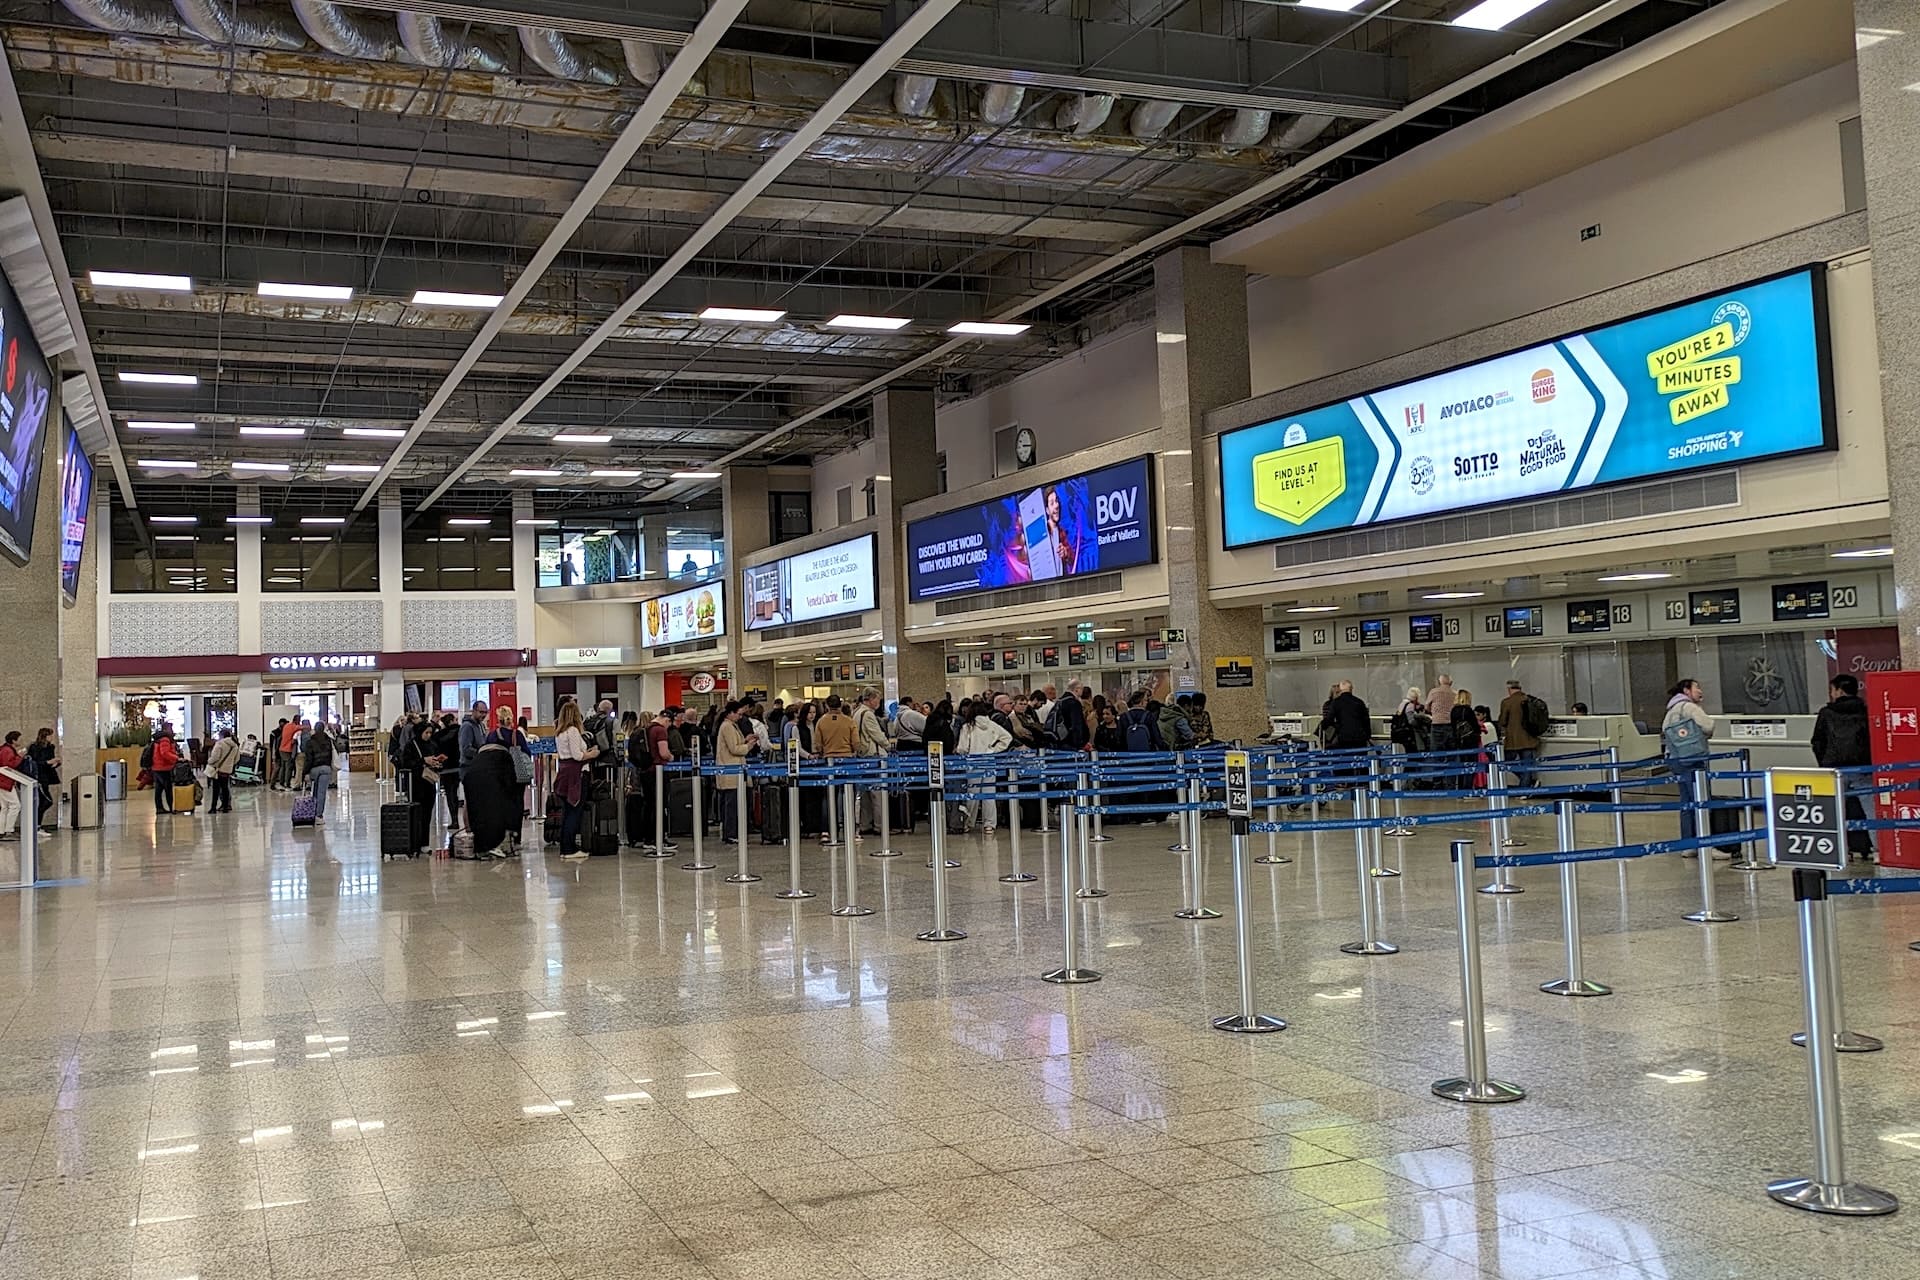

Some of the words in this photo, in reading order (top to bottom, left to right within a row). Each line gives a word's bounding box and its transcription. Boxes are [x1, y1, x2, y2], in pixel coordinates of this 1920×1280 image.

[1656, 336, 1712, 369] YOU'RE
[1716, 331, 1725, 345] 2
[1531, 377, 1555, 389] BURGER
[1665, 364, 1732, 387] MINUTES
[1532, 384, 1556, 399] KING
[1440, 395, 1494, 420] AVOTACO
[1677, 388, 1720, 418] AWAY
[1410, 426, 1423, 434] KFC
[1703, 431, 1727, 441] AIRPORT
[1520, 439, 1566, 465] NATURAL
[1668, 438, 1728, 459] SHOPPING
[1274, 468, 1293, 481] FIND
[1294, 465, 1306, 476] US
[1308, 462, 1318, 473] AT
[1520, 461, 1543, 477] GOOD
[1545, 452, 1566, 468] FOOD
[1281, 478, 1304, 491] LEVEL
[1306, 475, 1315, 485] -1
[1096, 486, 1138, 525] BOV
[1098, 533, 1111, 546] Bank
[1111, 531, 1117, 543] of
[1117, 528, 1140, 541] Valletta
[918, 541, 946, 560] DISCOVER
[946, 538, 959, 552] THE
[959, 533, 983, 550] WORLD
[919, 560, 935, 574] WITH
[935, 556, 952, 571] YOUR
[952, 552, 966, 567] BOV
[966, 548, 988, 565] CARDS
[842, 584, 857, 601] fino
[1833, 588, 1856, 607] 20
[672, 606, 683, 617] LEVEL
[1613, 607, 1630, 623] 18
[1667, 602, 1683, 618] 19
[1446, 620, 1458, 634] 16
[1487, 616, 1500, 631] 17
[1314, 630, 1324, 644] 14
[1346, 628, 1357, 641] 15
[579, 649, 599, 657] BOV
[269, 656, 316, 670] COSTA
[320, 656, 376, 668] COFFEE
[1234, 772, 1244, 785] 24
[1232, 792, 1241, 805] 25
[1797, 805, 1824, 824] 26
[1788, 835, 1815, 854] 27
